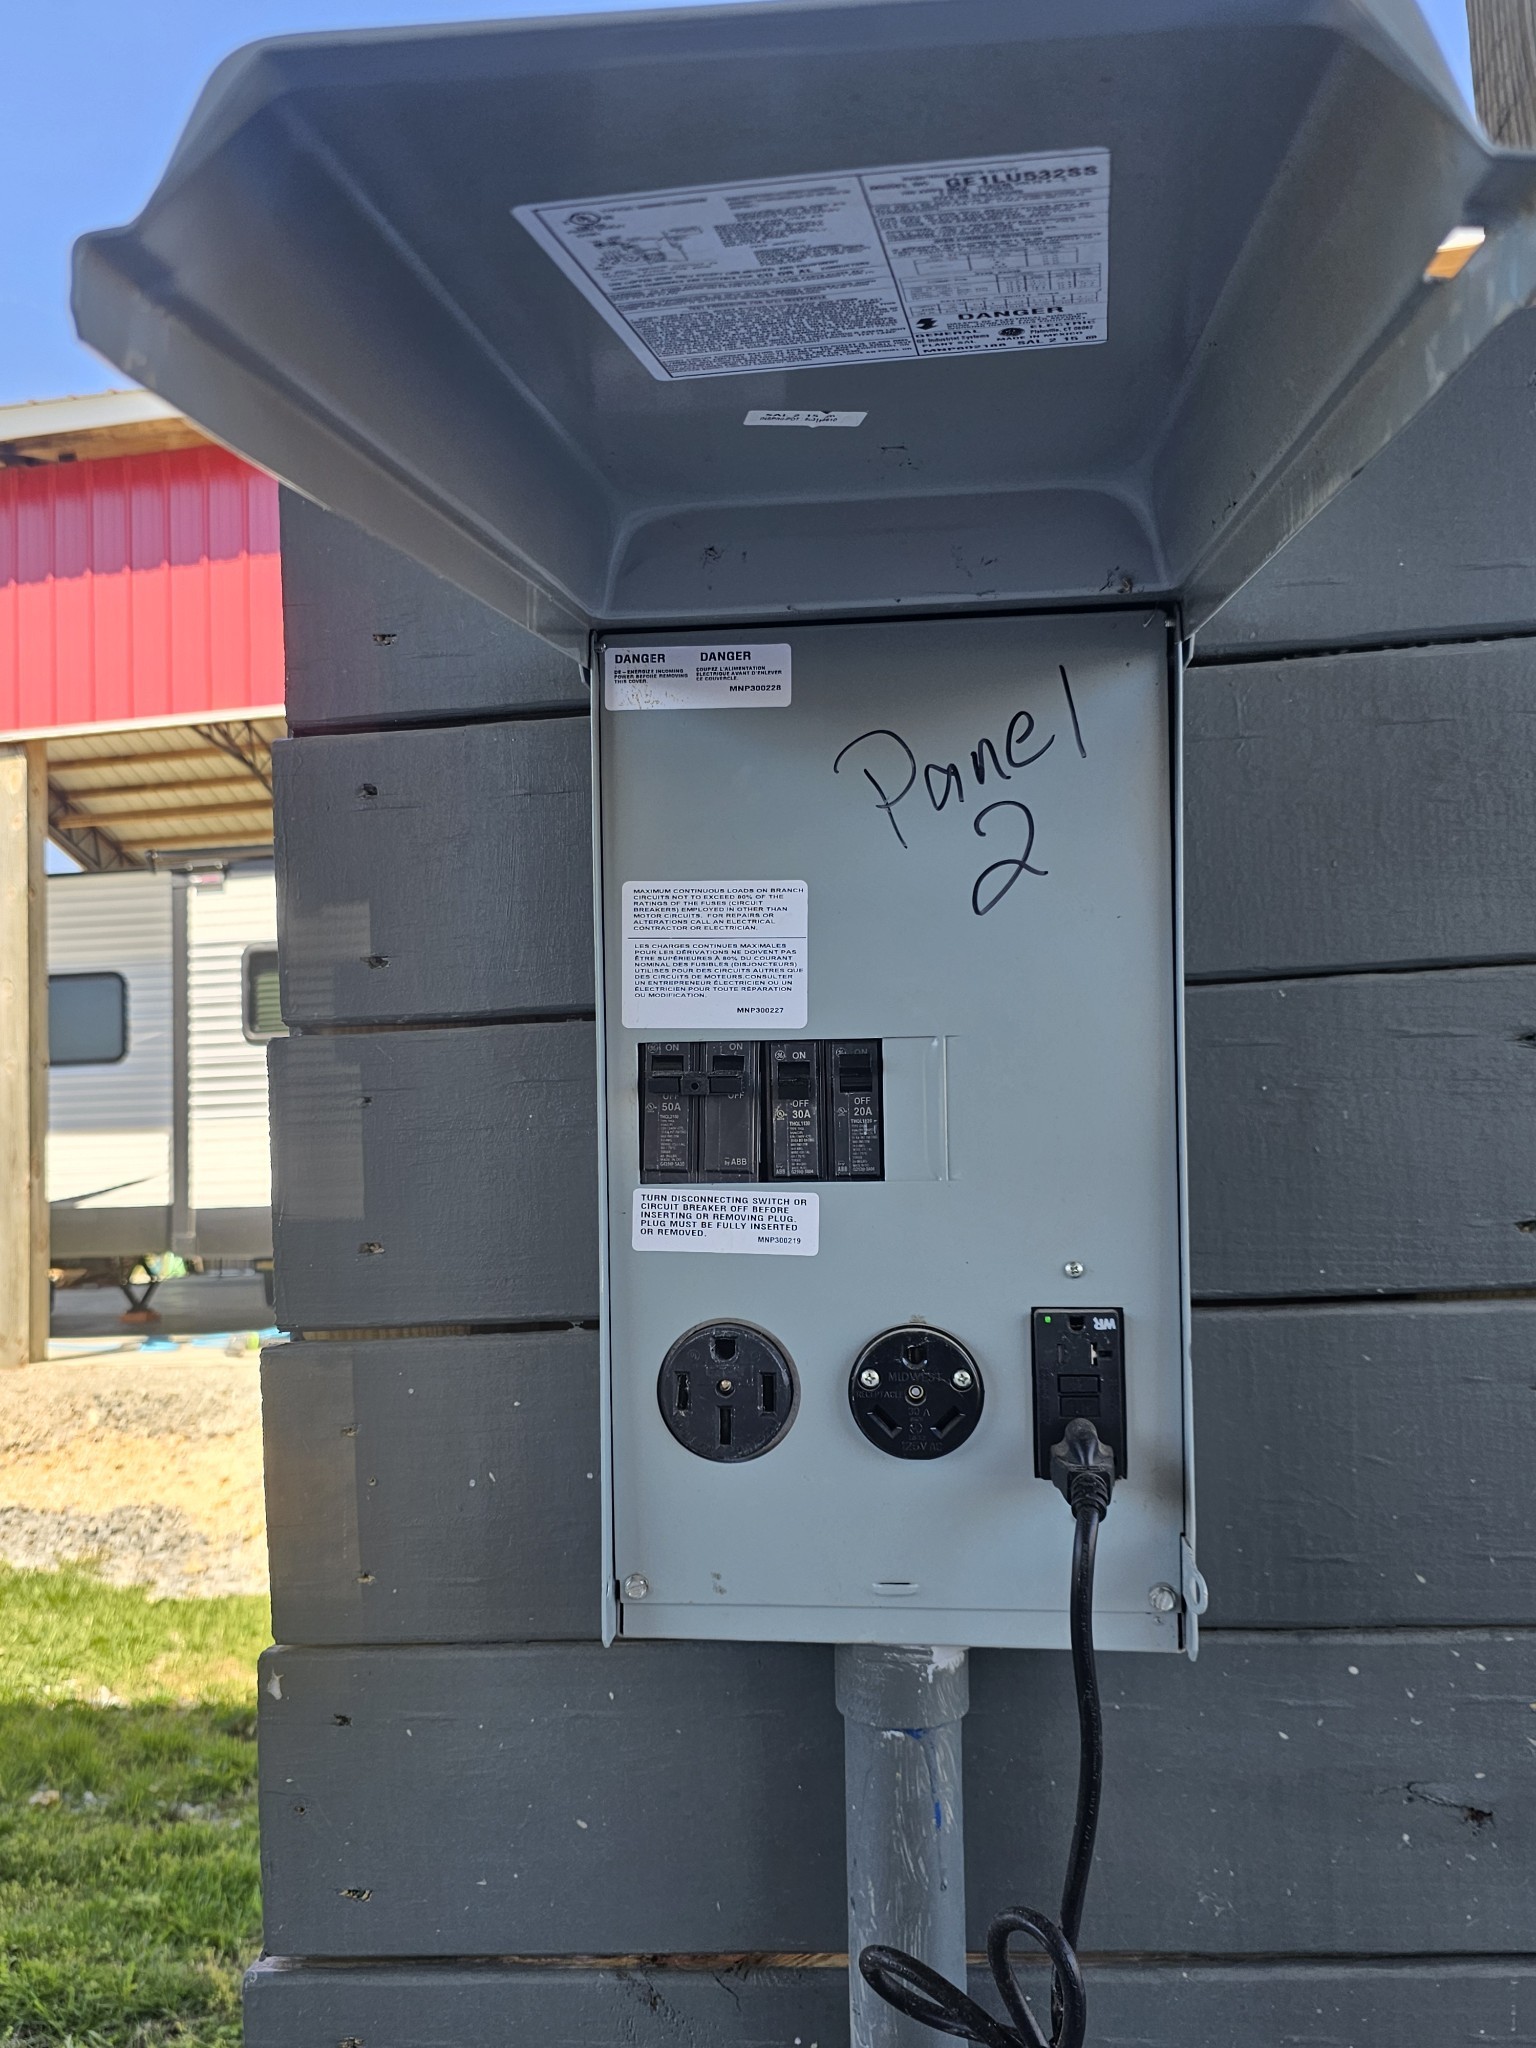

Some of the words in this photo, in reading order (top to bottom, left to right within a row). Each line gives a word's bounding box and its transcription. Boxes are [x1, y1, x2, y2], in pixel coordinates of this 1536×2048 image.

[958, 306, 1064, 321] DANGER
[615, 654, 665, 664] DANGER
[700, 651, 751, 662] DANGER
[834, 664, 1087, 849] Panel
[972, 800, 1049, 916] 2
[792, 1051, 806, 1059] ON
[662, 1102, 681, 1111] 50A
[854, 1107, 872, 1116] 20A
[792, 1110, 811, 1118] 30A
[671, 1195, 748, 1204] DISCONNECTING
[641, 1202, 679, 1211] CIRCUIT
[683, 1204, 726, 1212] BREAKER
[752, 1206, 788, 1214] BEFORE
[641, 1211, 692, 1221] INSERTING
[713, 1213, 764, 1221] REMOVING
[750, 1223, 798, 1231] INSERTED
[658, 1228, 706, 1237] REMOVED.
[758, 1236, 801, 1244] MNP300219
[1092, 1317, 1116, 1330] WR
[888, 1372, 944, 1382] MIDWEST
